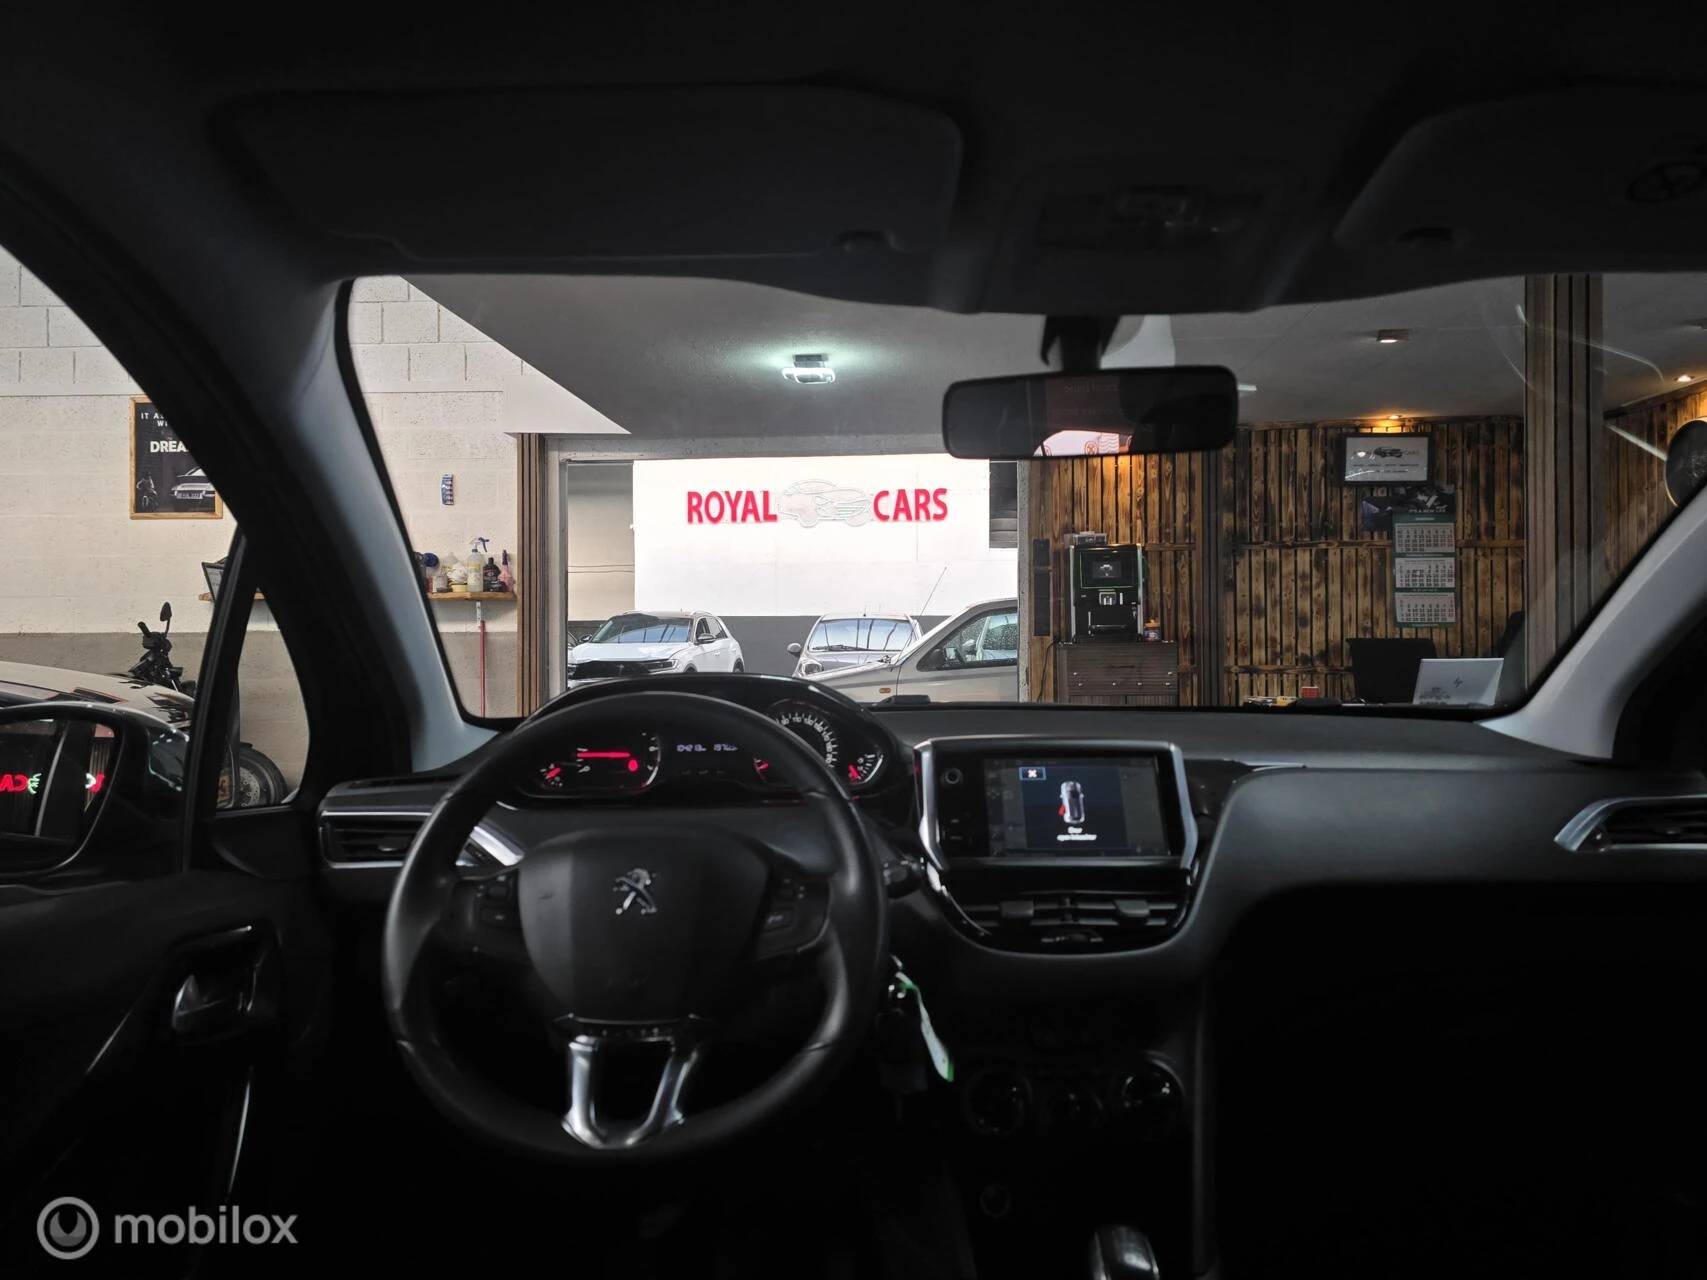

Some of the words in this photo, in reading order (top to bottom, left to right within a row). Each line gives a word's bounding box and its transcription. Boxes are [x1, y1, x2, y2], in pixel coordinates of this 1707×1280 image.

[150, 440, 189, 453] DREA
[687, 490, 778, 524] ROYAL
[873, 488, 948, 522] CARS
